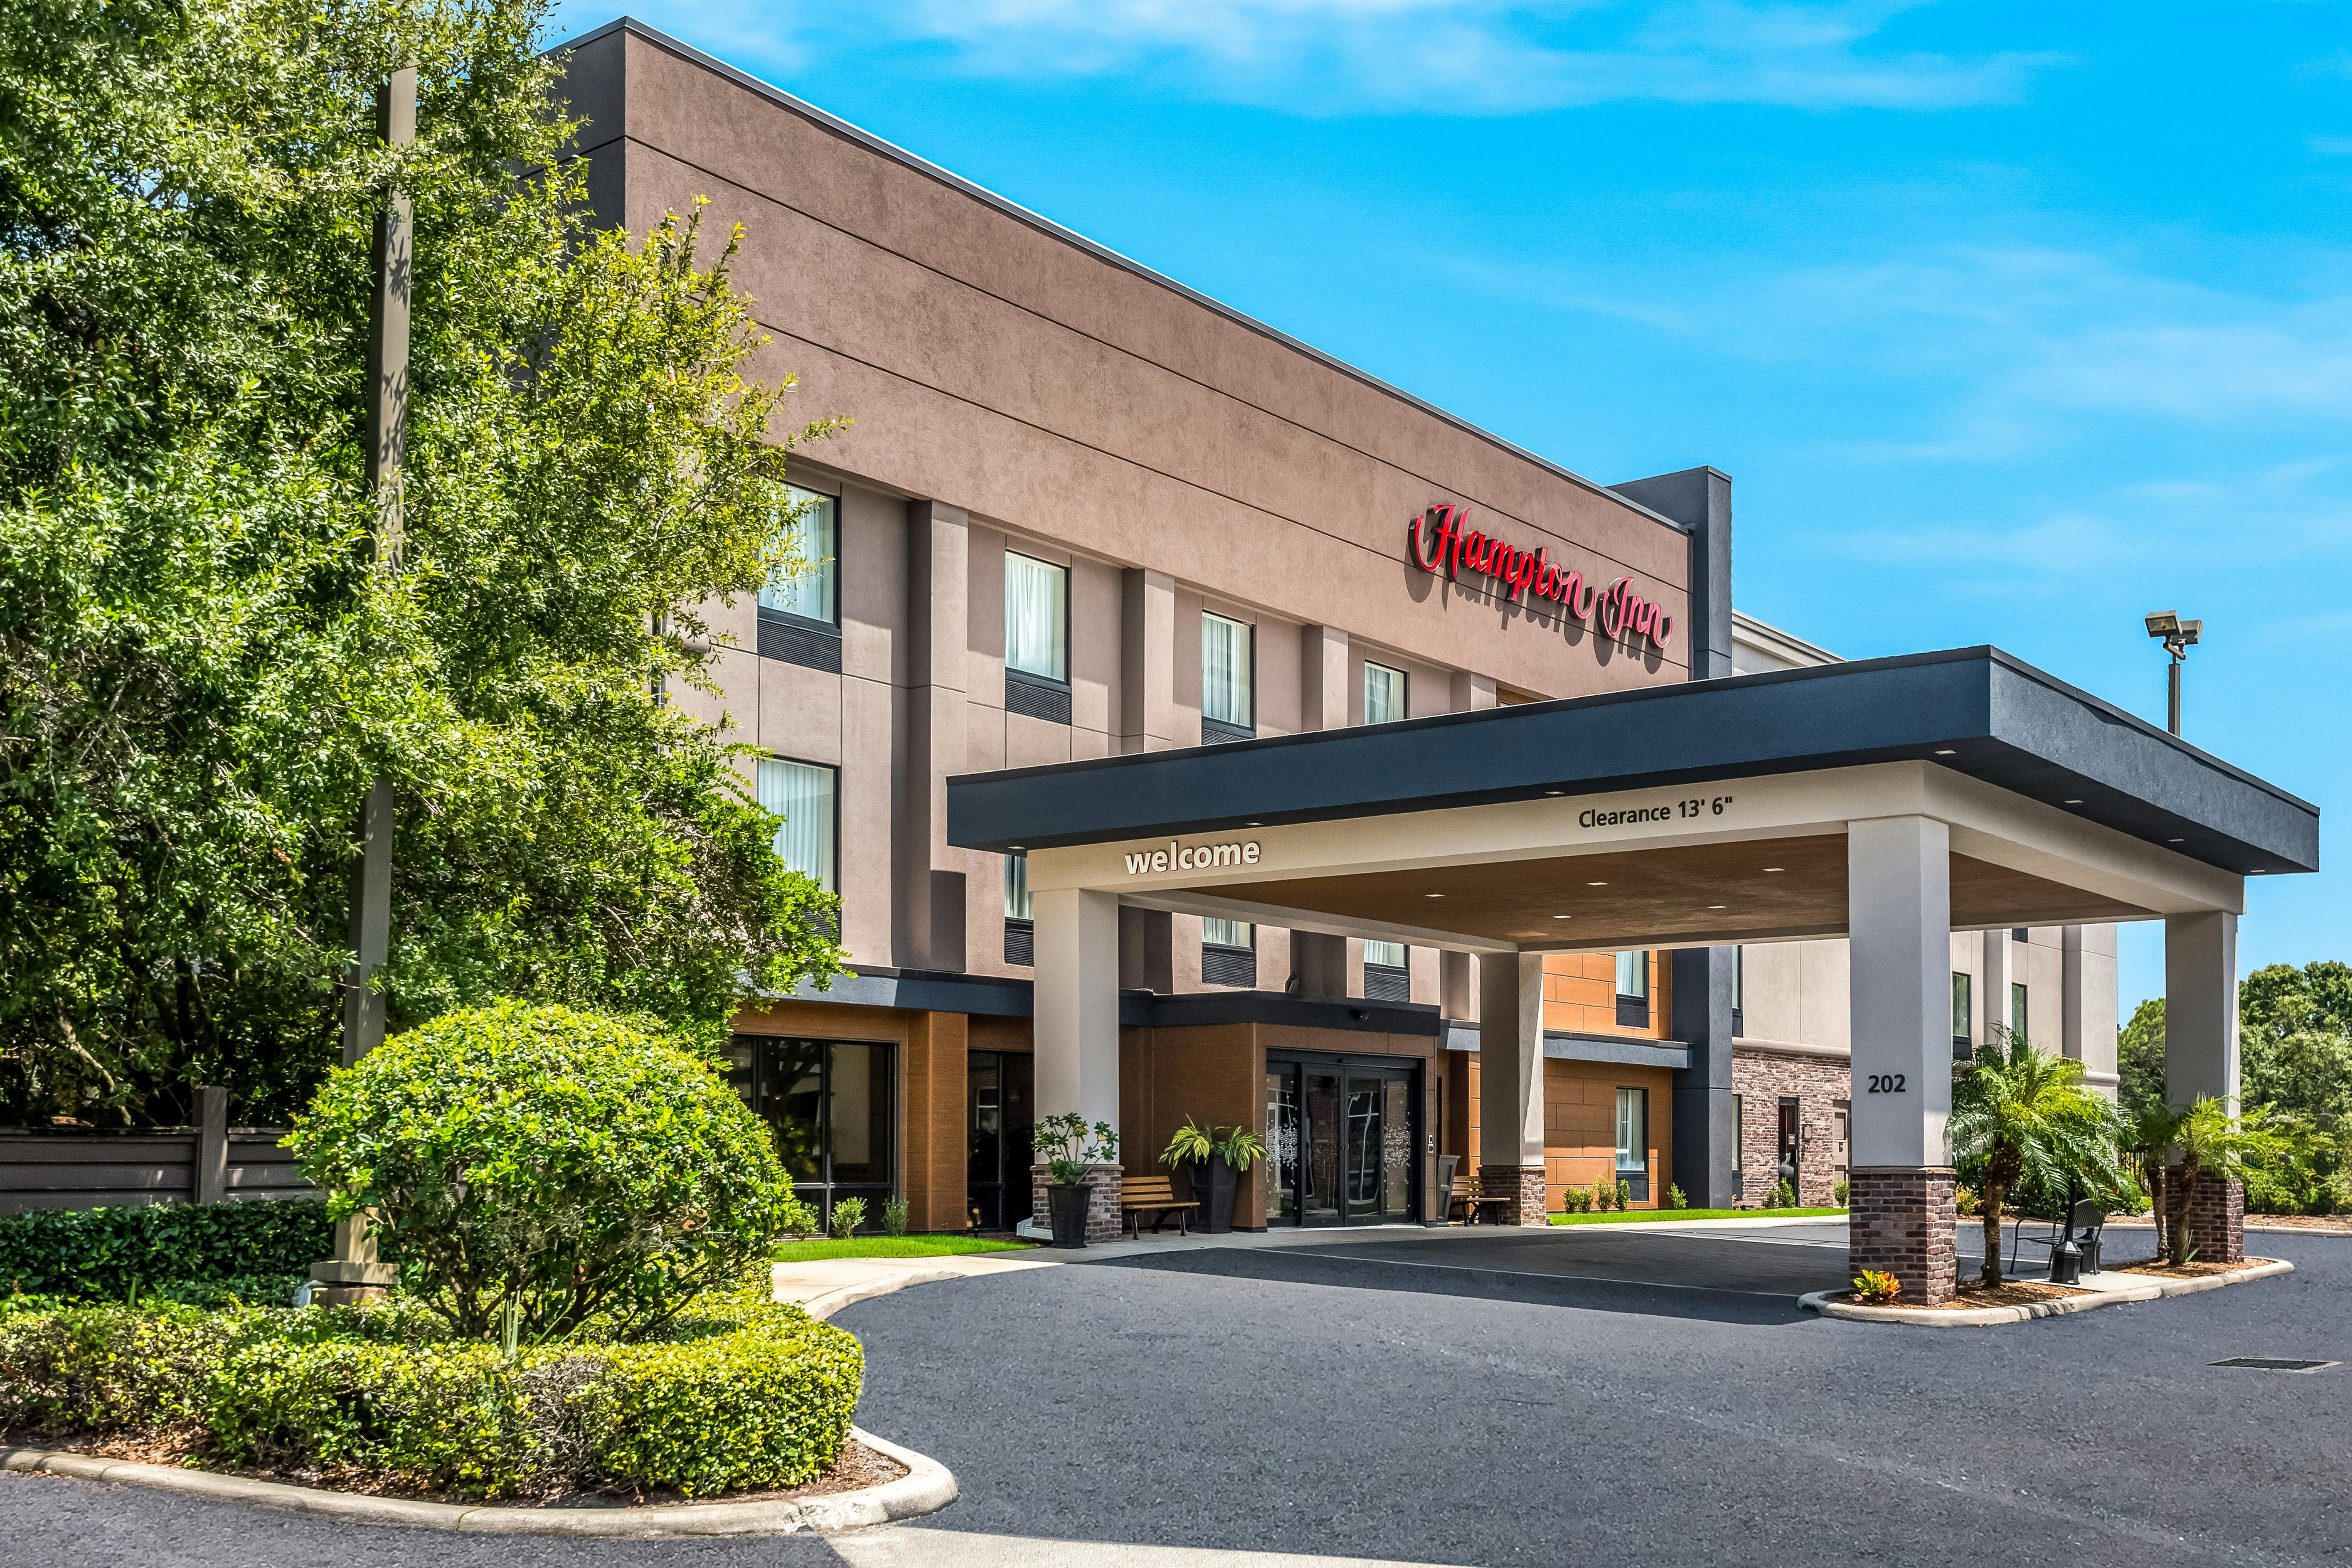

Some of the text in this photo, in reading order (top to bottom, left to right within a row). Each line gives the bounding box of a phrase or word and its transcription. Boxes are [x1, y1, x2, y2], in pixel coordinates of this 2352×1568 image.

[1409, 505, 1673, 648] Hampton Inn
[1579, 796, 1733, 828] Clearance 13' 6"
[1125, 841, 1261, 875] welcome
[1868, 1074, 1906, 1093] 202
